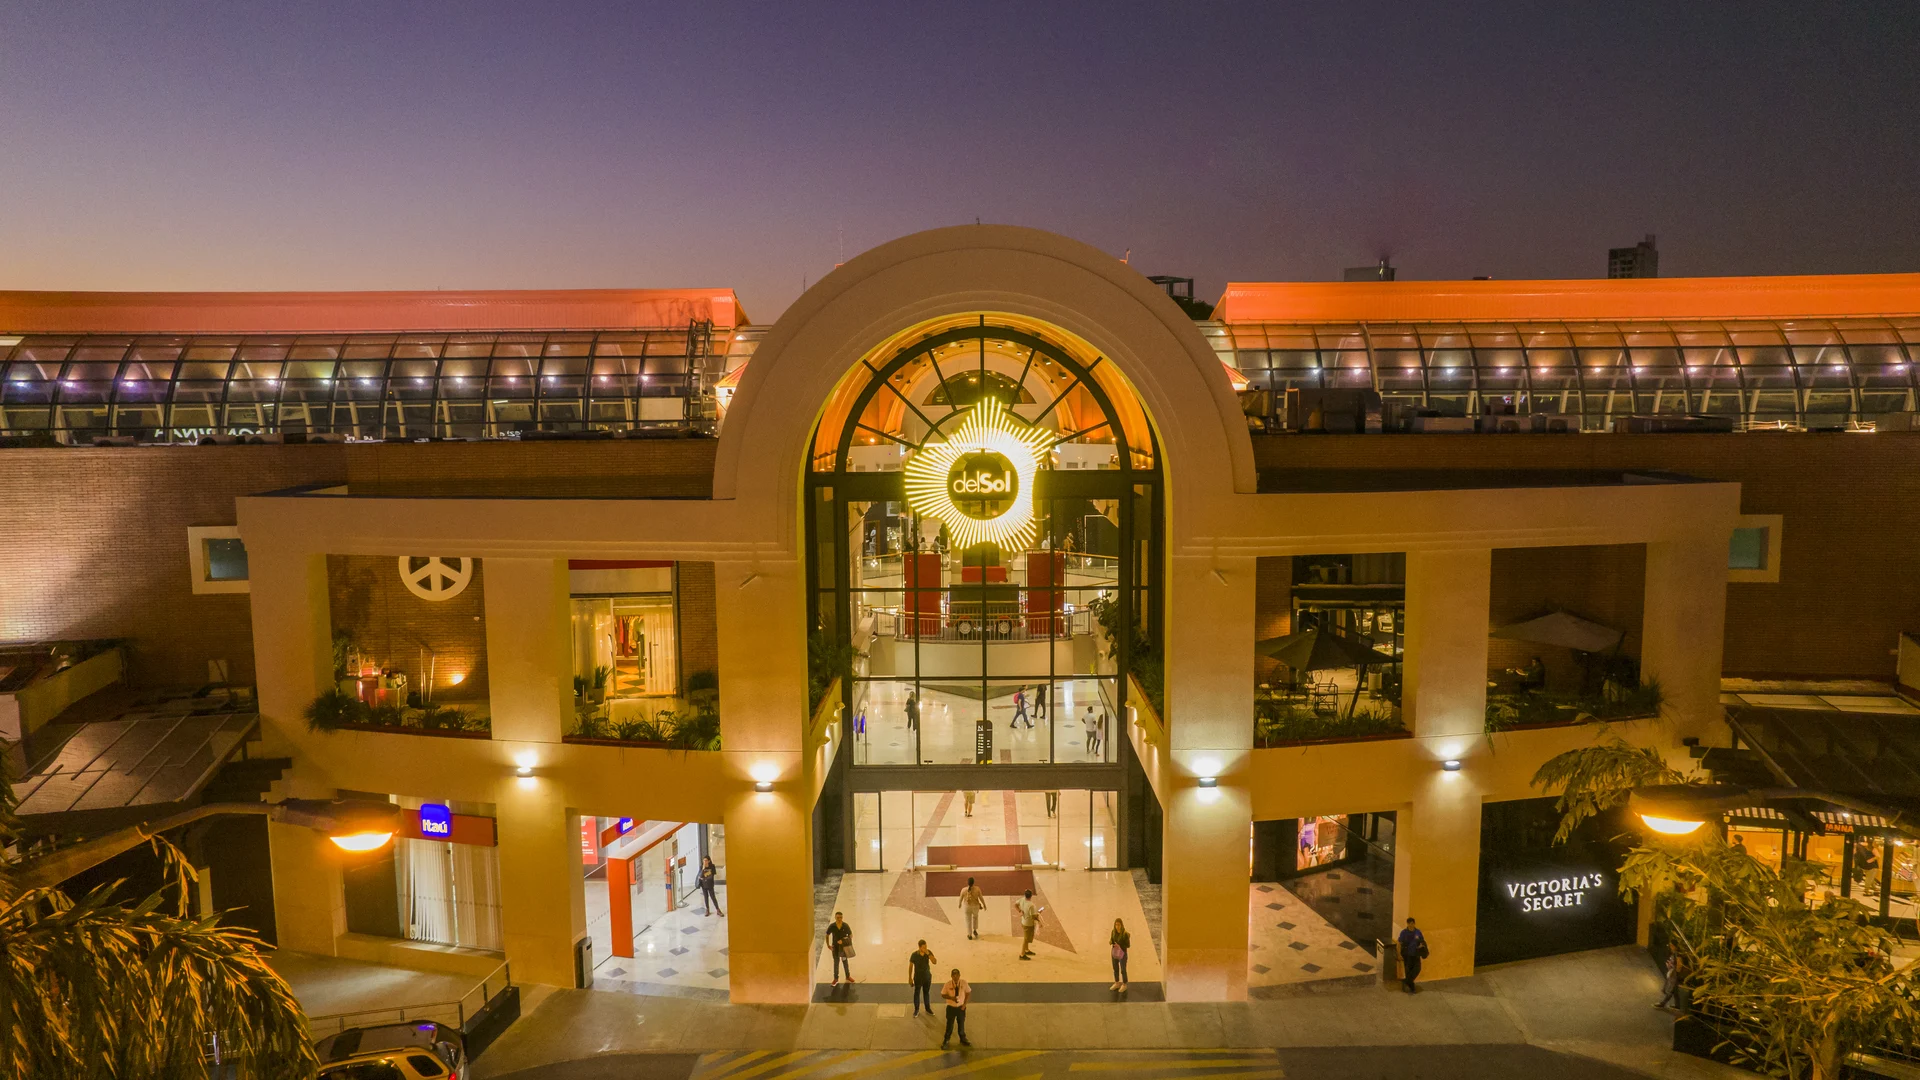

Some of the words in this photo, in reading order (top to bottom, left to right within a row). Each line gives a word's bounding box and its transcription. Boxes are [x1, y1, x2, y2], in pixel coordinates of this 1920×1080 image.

[953, 470, 1011, 493] delSol
[422, 819, 448, 834] Itaú
[1507, 873, 1602, 898] VICTORIA'S
[1523, 892, 1584, 912] SECRET
